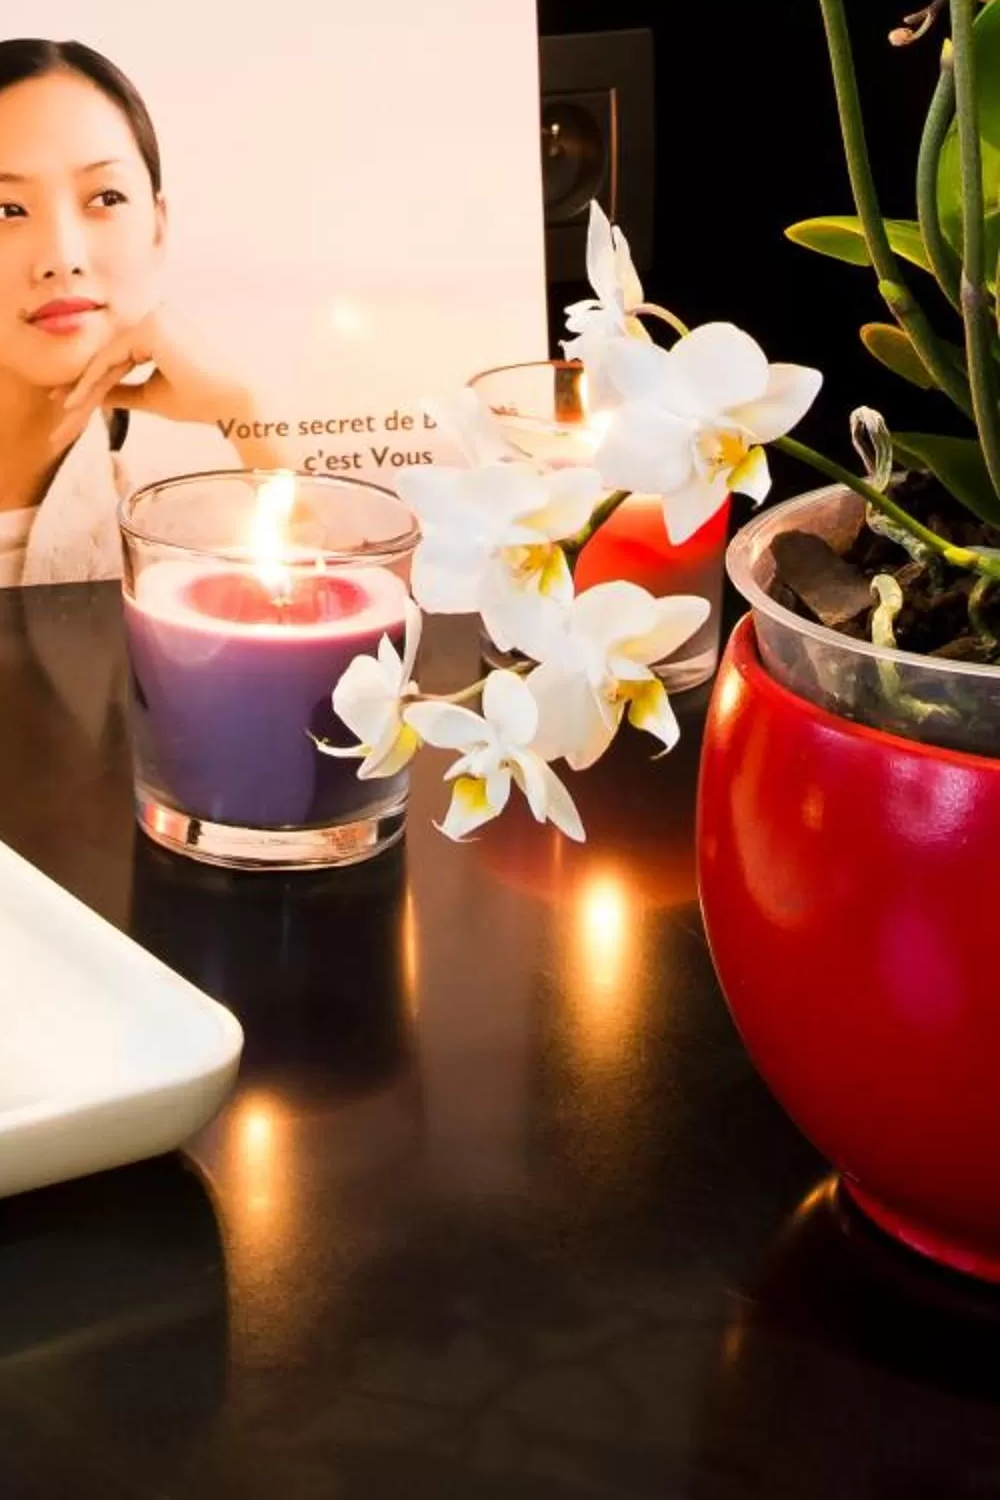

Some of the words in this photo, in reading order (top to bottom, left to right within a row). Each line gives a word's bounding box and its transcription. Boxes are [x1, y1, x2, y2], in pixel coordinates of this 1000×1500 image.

[216, 417, 289, 439] Votre
[299, 414, 375, 435] secret
[384, 410, 414, 431] de
[304, 449, 361, 472] c'est
[370, 446, 433, 468] Vous
